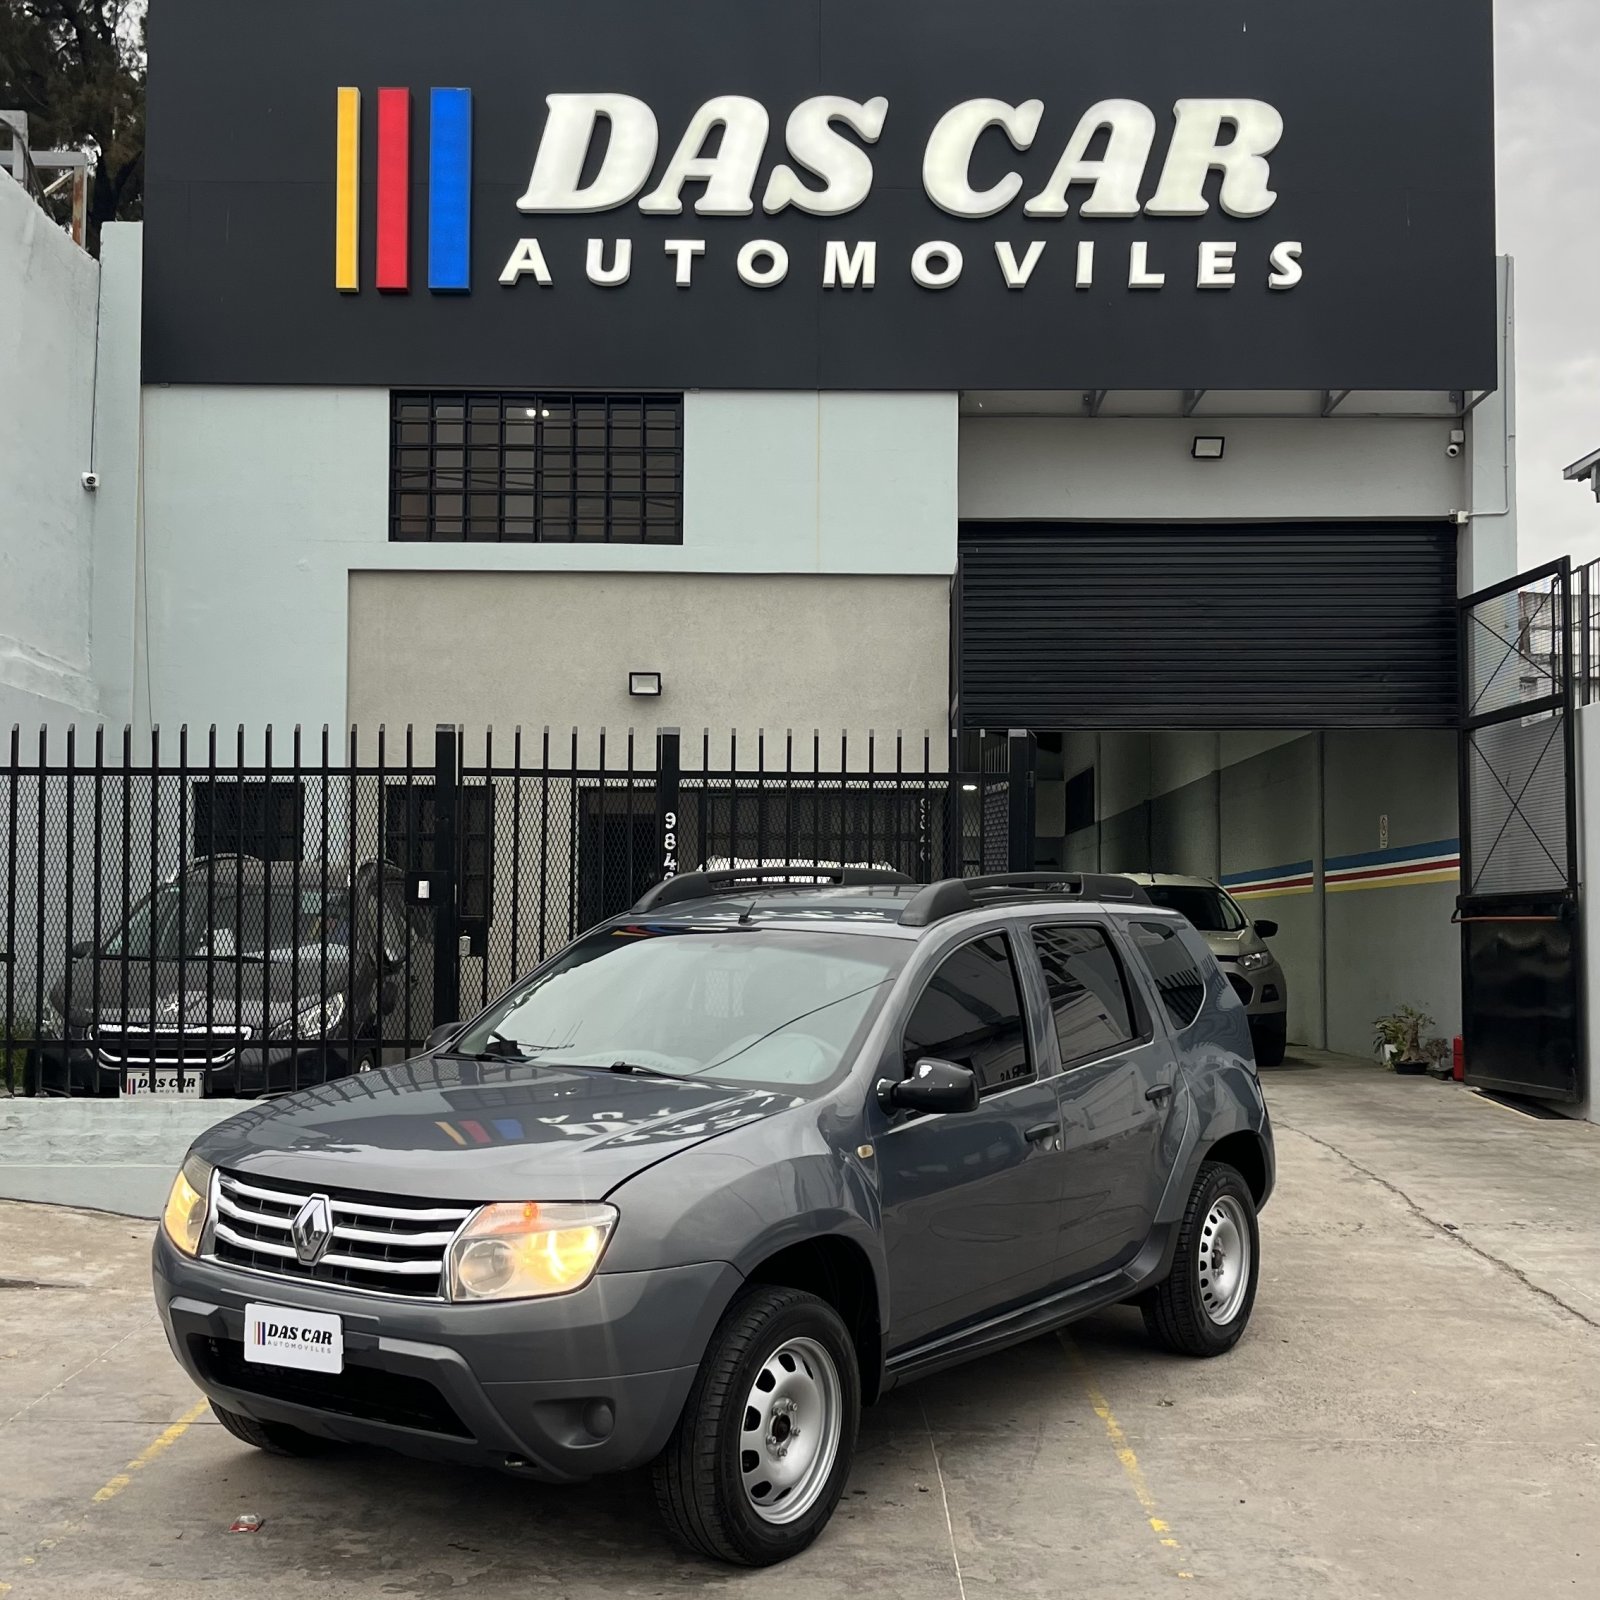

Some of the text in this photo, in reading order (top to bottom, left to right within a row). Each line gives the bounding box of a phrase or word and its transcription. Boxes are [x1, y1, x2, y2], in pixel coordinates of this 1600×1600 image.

[516, 93, 1284, 218] DAS CAR
[498, 238, 1303, 290] AUTOMOVILES
[267, 1323, 333, 1345] DAS CAR
[267, 1340, 332, 1354] AUTOMOVILES
